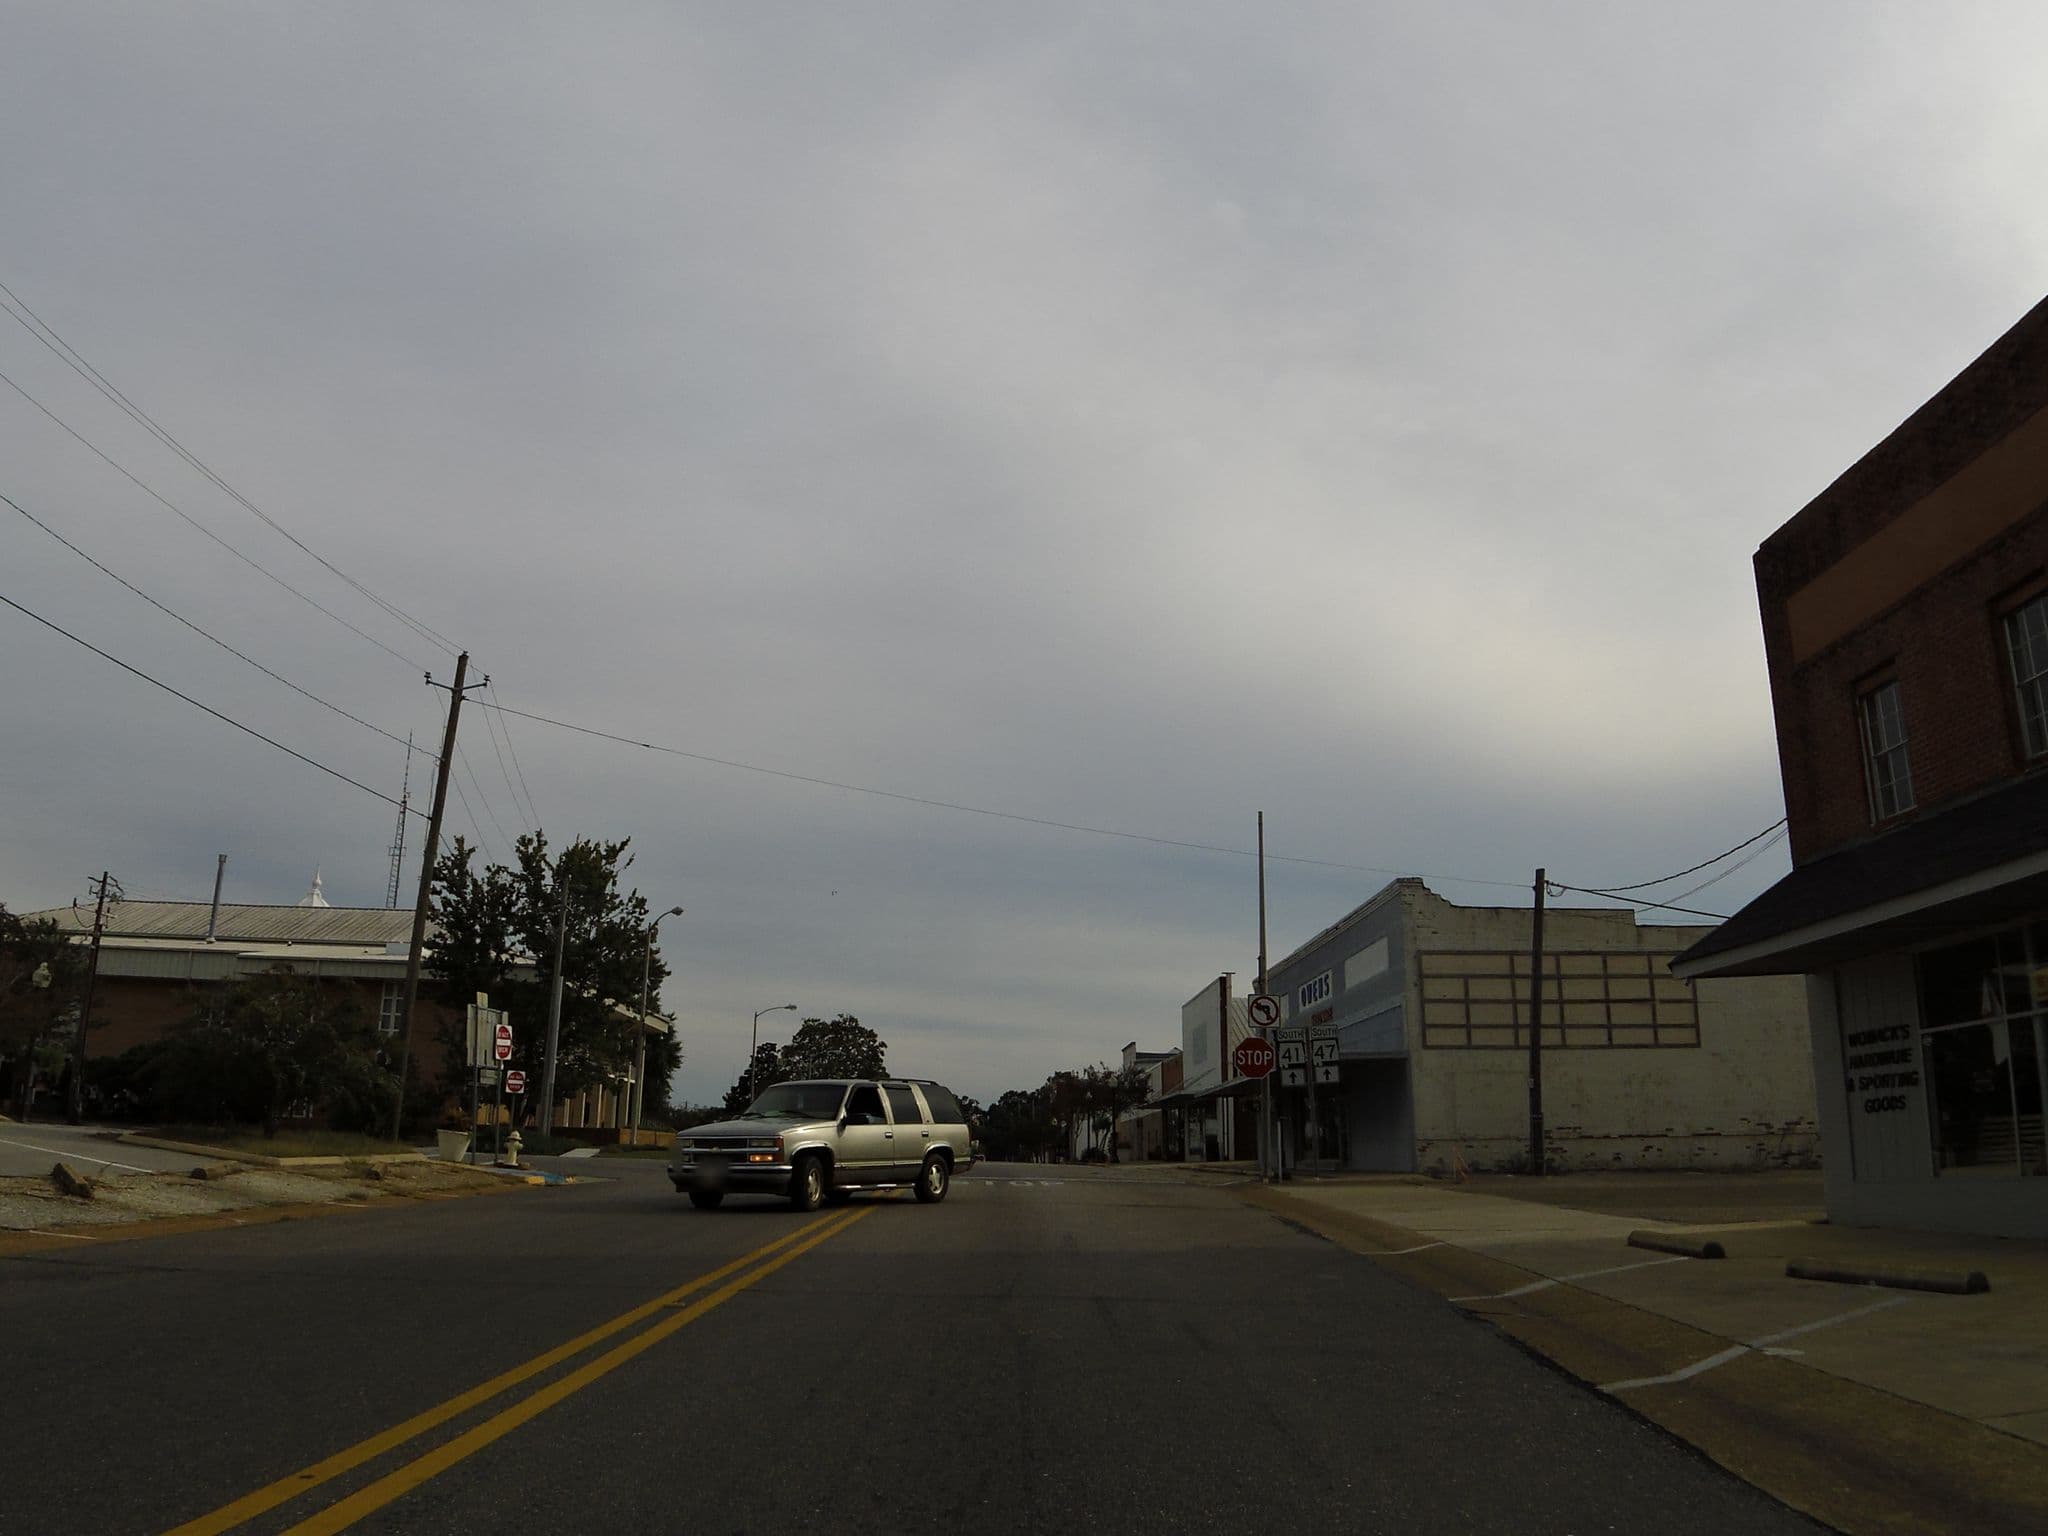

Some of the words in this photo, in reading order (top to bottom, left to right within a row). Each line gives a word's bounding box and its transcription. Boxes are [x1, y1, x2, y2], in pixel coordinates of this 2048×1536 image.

[1278, 1030, 1304, 1040] SOUTH
[1312, 1027, 1338, 1037] SOUTH
[1237, 1049, 1273, 1066] STOP
[1281, 1047, 1299, 1062] 41
[1313, 1044, 1336, 1060] 47
[1858, 1071, 1919, 1090] SPORTING
[1864, 1095, 1906, 1114] GOODS
